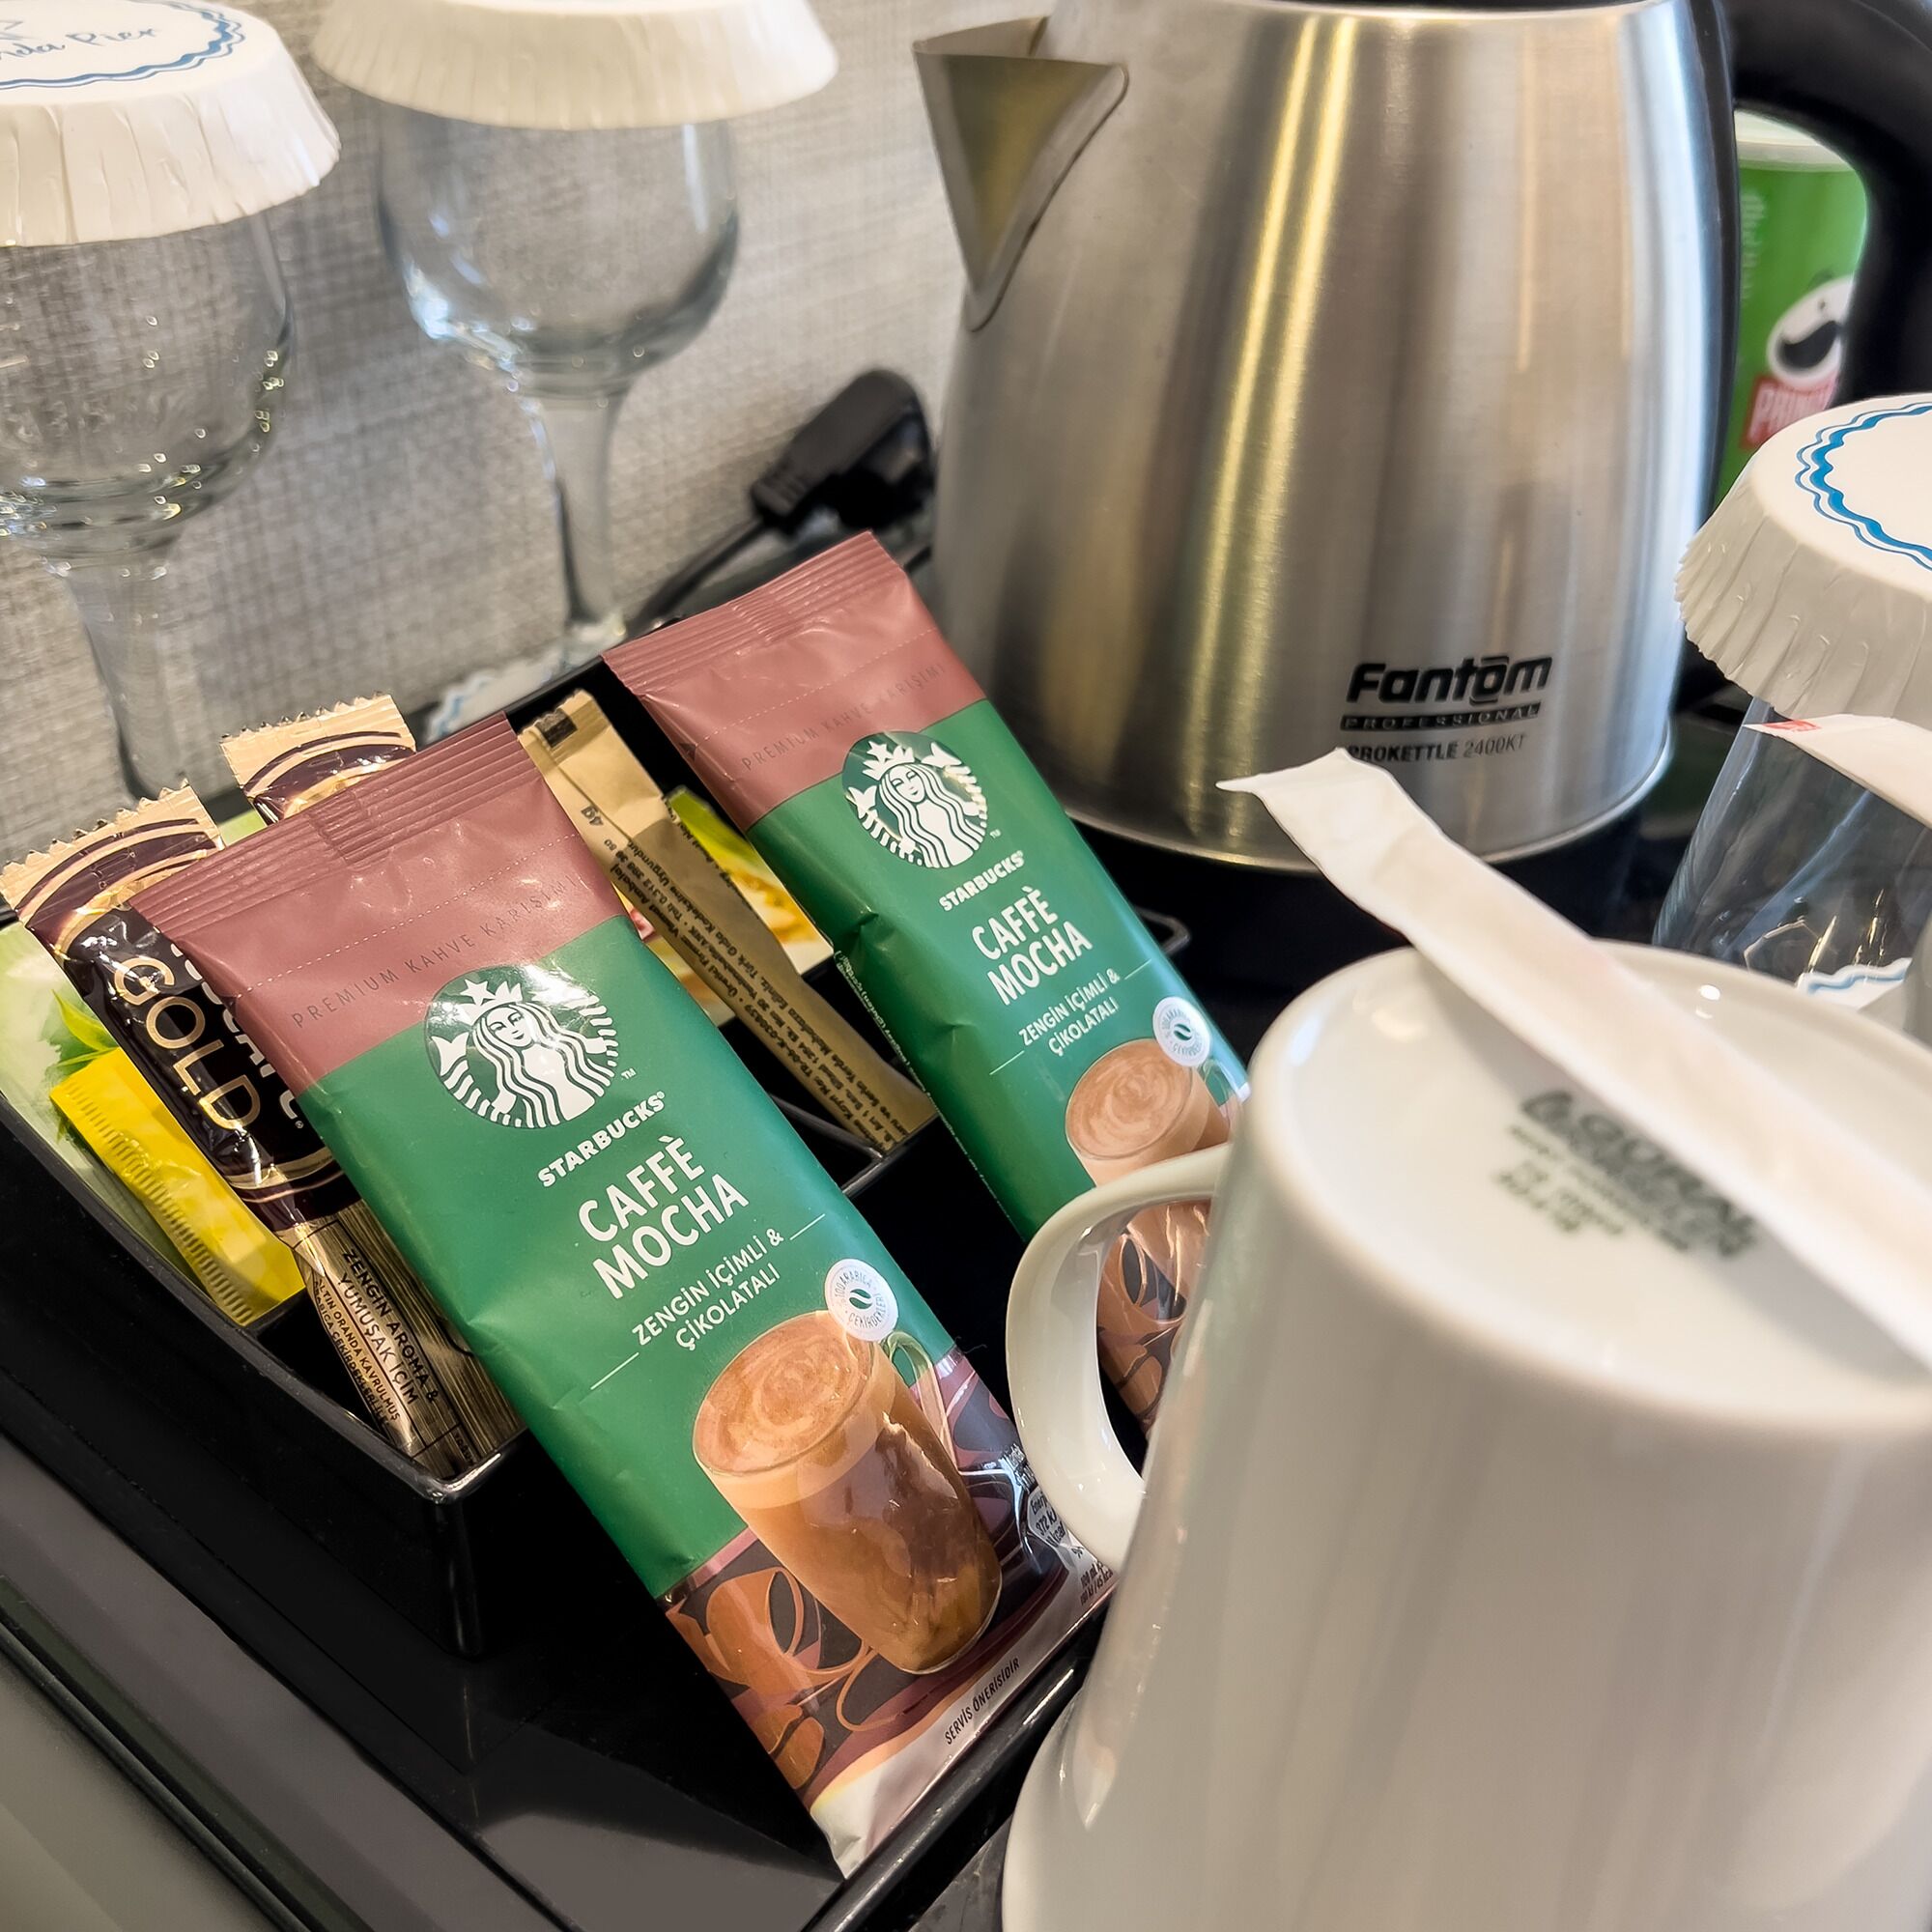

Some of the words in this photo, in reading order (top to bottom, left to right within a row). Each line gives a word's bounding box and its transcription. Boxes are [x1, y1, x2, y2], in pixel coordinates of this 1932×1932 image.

[741, 729, 820, 772] PREMIUM
[822, 701, 873, 733] KAHVE
[1342, 702, 1541, 730] PROFESSIONAL
[938, 851, 1025, 912] STARBUCKS
[971, 885, 1059, 960] CAFFÈ
[292, 968, 400, 1029] PREMIUM
[403, 933, 475, 974] KAHVE
[987, 921, 1094, 1006] MOCHA
[1018, 997, 1070, 1046] ZENGİN
[1065, 972, 1109, 1012] İÇİMLİ
[1105, 967, 1122, 985] &
[114, 956, 262, 1130] GOLD
[1048, 996, 1120, 1057] ÇİKOLATALI
[537, 1091, 667, 1188] STARBUCKS
[578, 1135, 705, 1242] CAFFÈ
[592, 1174, 749, 1299] MOCHA
[343, 1247, 392, 1318] ZENGİN
[386, 1321, 429, 1386] AROMA
[427, 1389, 439, 1405] &
[632, 1279, 710, 1347] ZENGİN
[704, 1235, 768, 1288] İÇİMLİ
[766, 1227, 784, 1247] &
[675, 1262, 781, 1351] ÇİKOLATALI
[334, 1309, 361, 1357] ORANDA
[359, 1354, 401, 1421] KAVRULMUŞ
[338, 1272, 396, 1361] YUMUŞAK
[389, 1360, 419, 1405] İÇİM
[945, 1706, 974, 1746] SERVİS
[972, 1657, 1021, 1712] ÖNERİSİDİR
